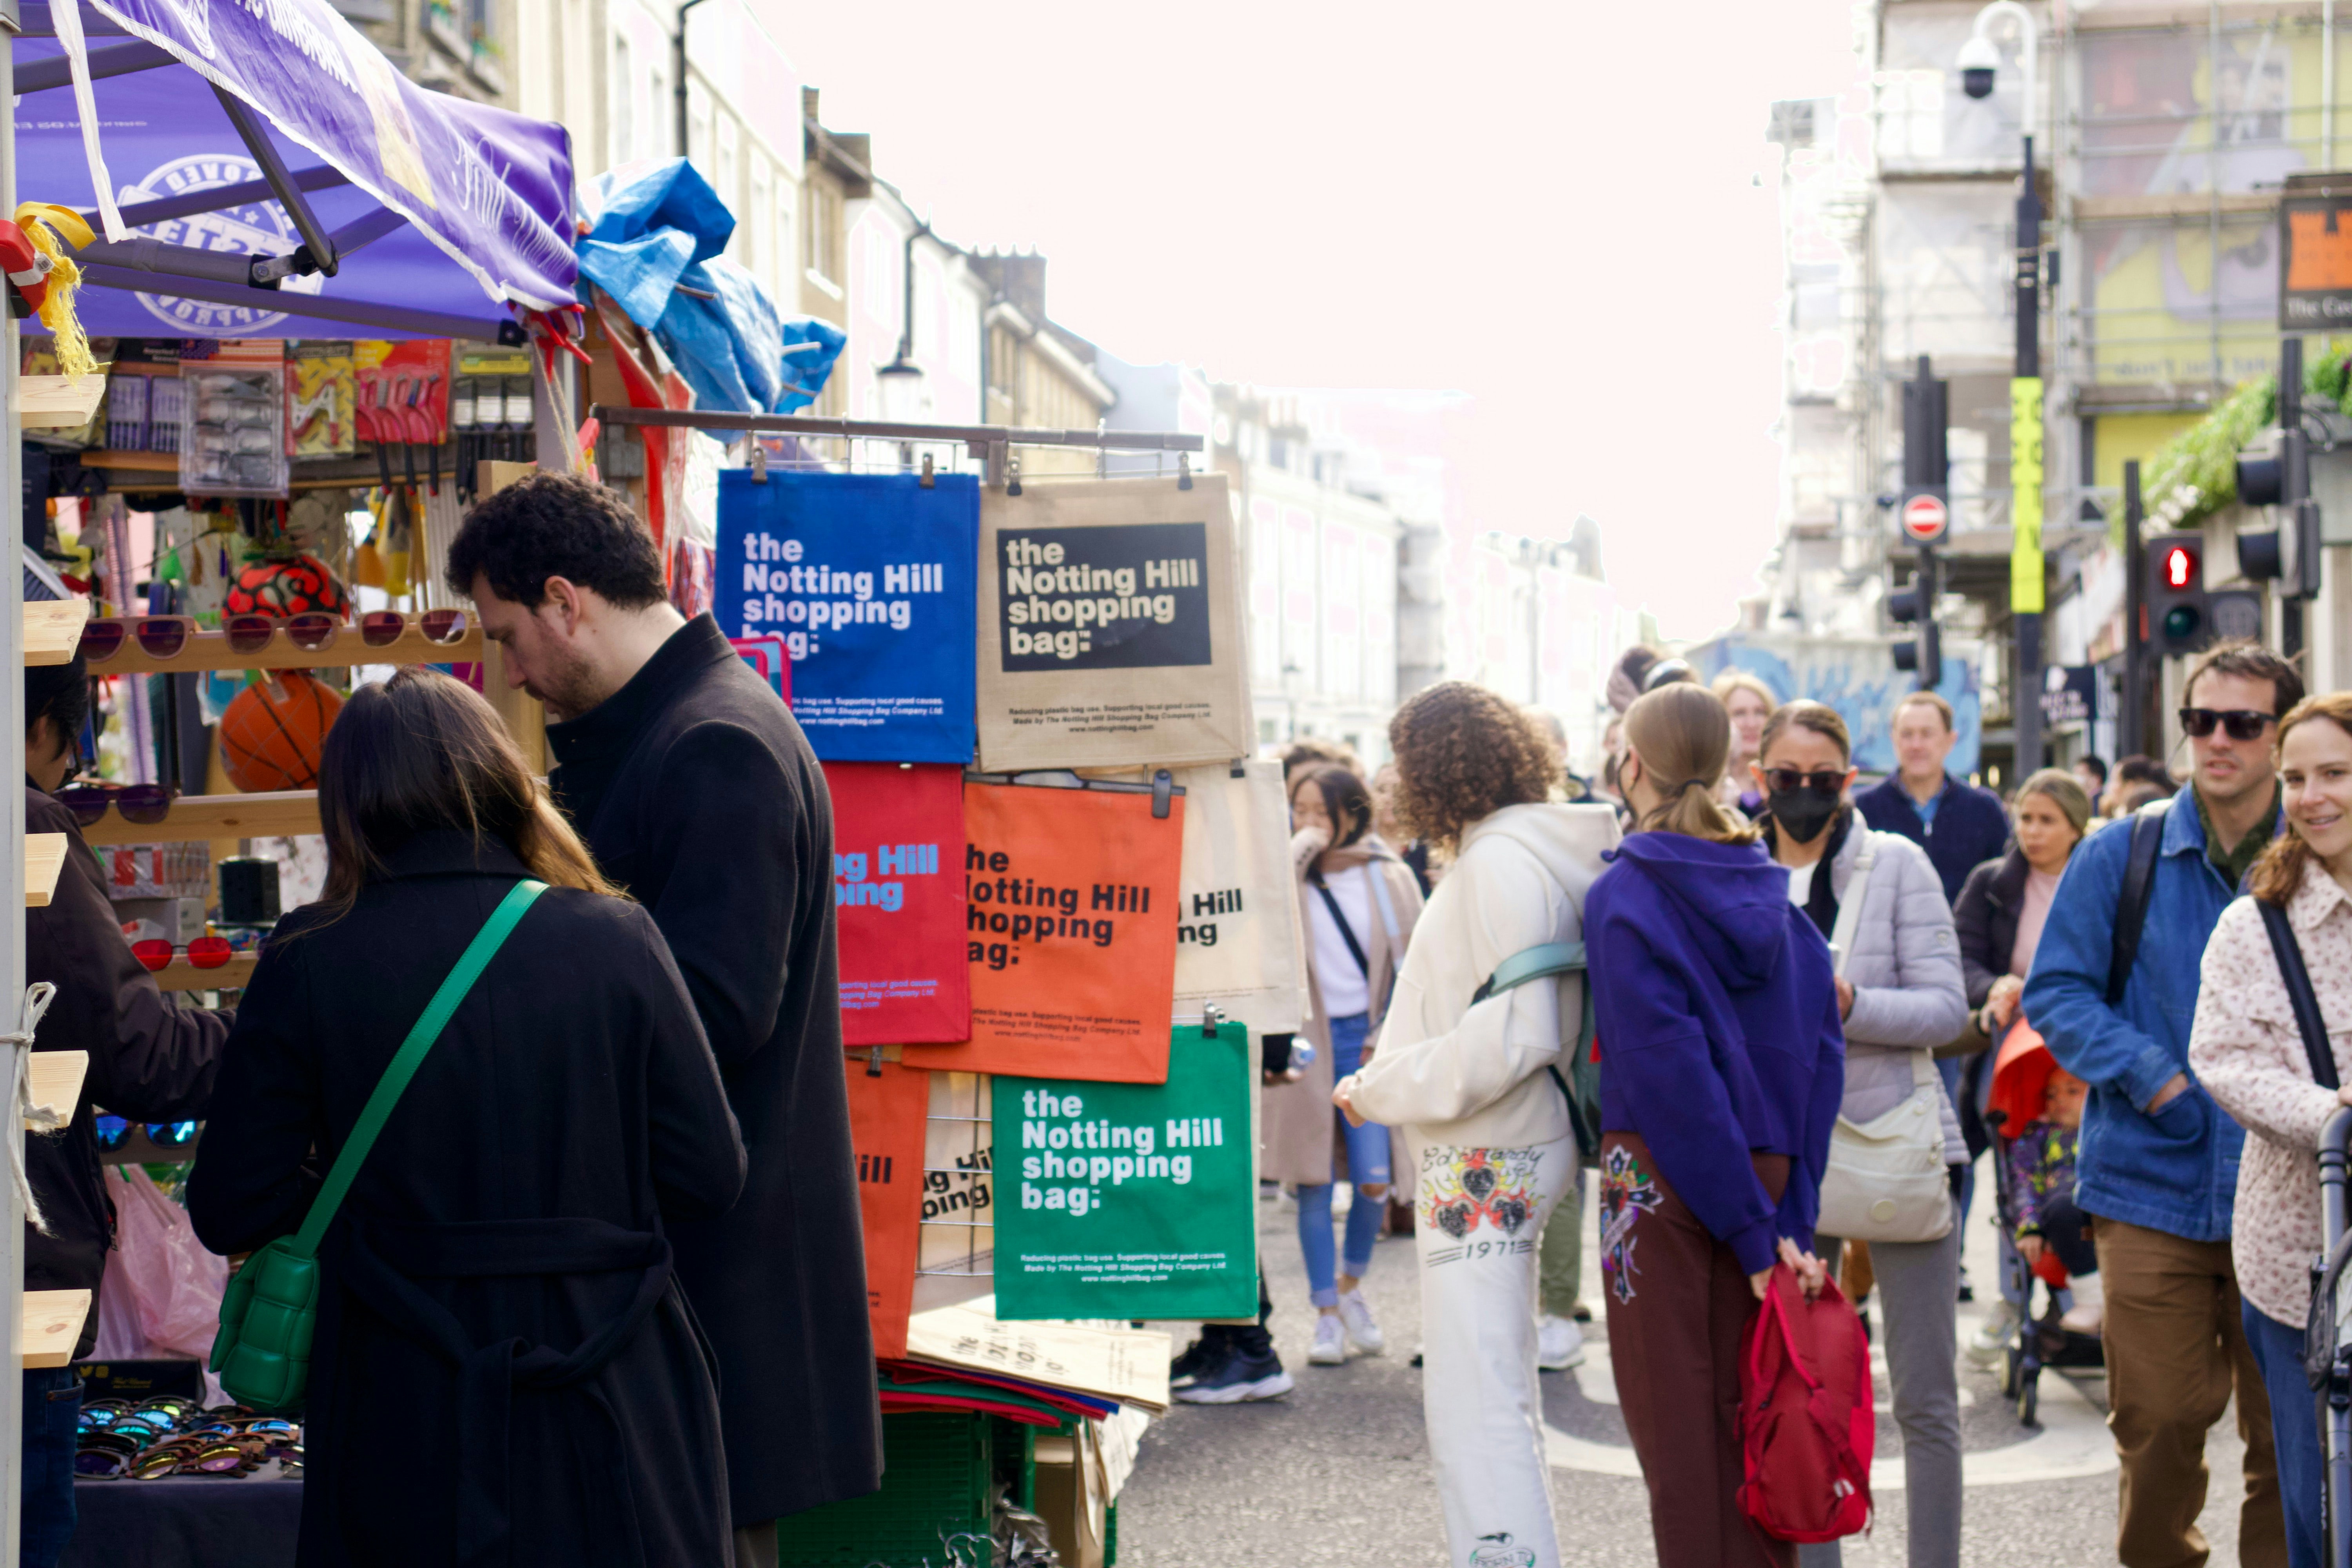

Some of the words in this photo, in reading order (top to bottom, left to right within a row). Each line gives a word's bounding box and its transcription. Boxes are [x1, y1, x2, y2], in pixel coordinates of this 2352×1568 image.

[743, 532, 803, 563] the
[1006, 538, 1065, 566] the
[743, 563, 873, 601] Notting
[884, 563, 942, 594] Hill
[1007, 563, 1136, 597] Notting
[1145, 558, 1199, 589] Hill
[743, 593, 911, 631] shopping
[1008, 594, 1175, 628] shopping
[878, 844, 939, 875] Hill
[966, 843, 1009, 873] he
[966, 874, 1079, 916] otting
[1092, 884, 1150, 914] Hill
[1192, 888, 1243, 917] Hill
[967, 904, 1114, 948] hopping
[968, 941, 1020, 971] ag:
[1022, 1089, 1083, 1118] the
[1022, 1119, 1155, 1156] Notting
[1166, 1118, 1223, 1148] Hill
[854, 1155, 893, 1184] ill
[1022, 1150, 1192, 1185] shopping
